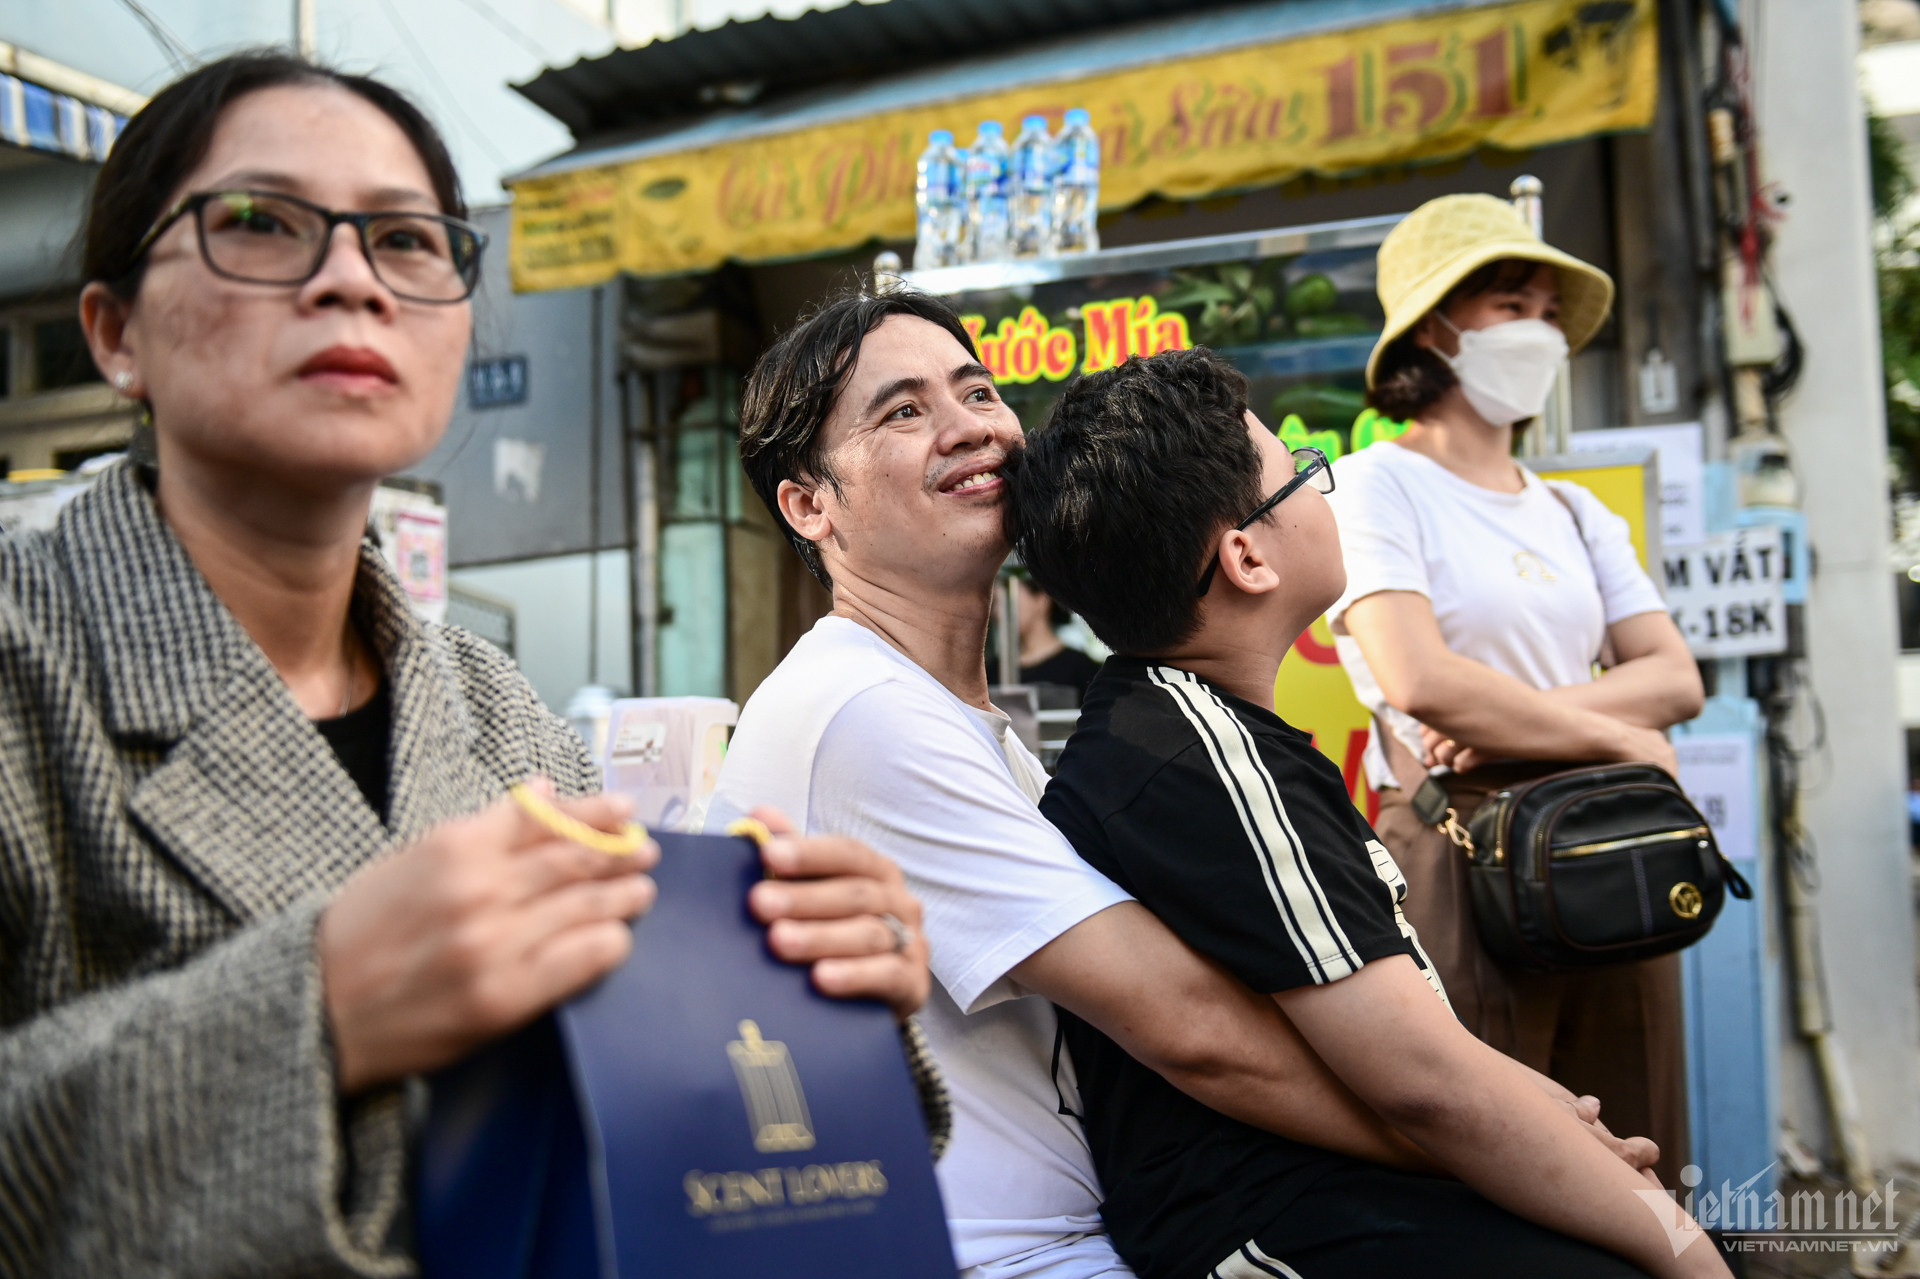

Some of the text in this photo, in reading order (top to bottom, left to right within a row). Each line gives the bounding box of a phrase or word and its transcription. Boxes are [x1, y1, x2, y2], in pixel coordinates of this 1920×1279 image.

[806, 133, 913, 227] Ph
[1318, 28, 1520, 147] 151
[1081, 296, 1192, 374] Mía
[785, 1159, 889, 1205] LOVERS
